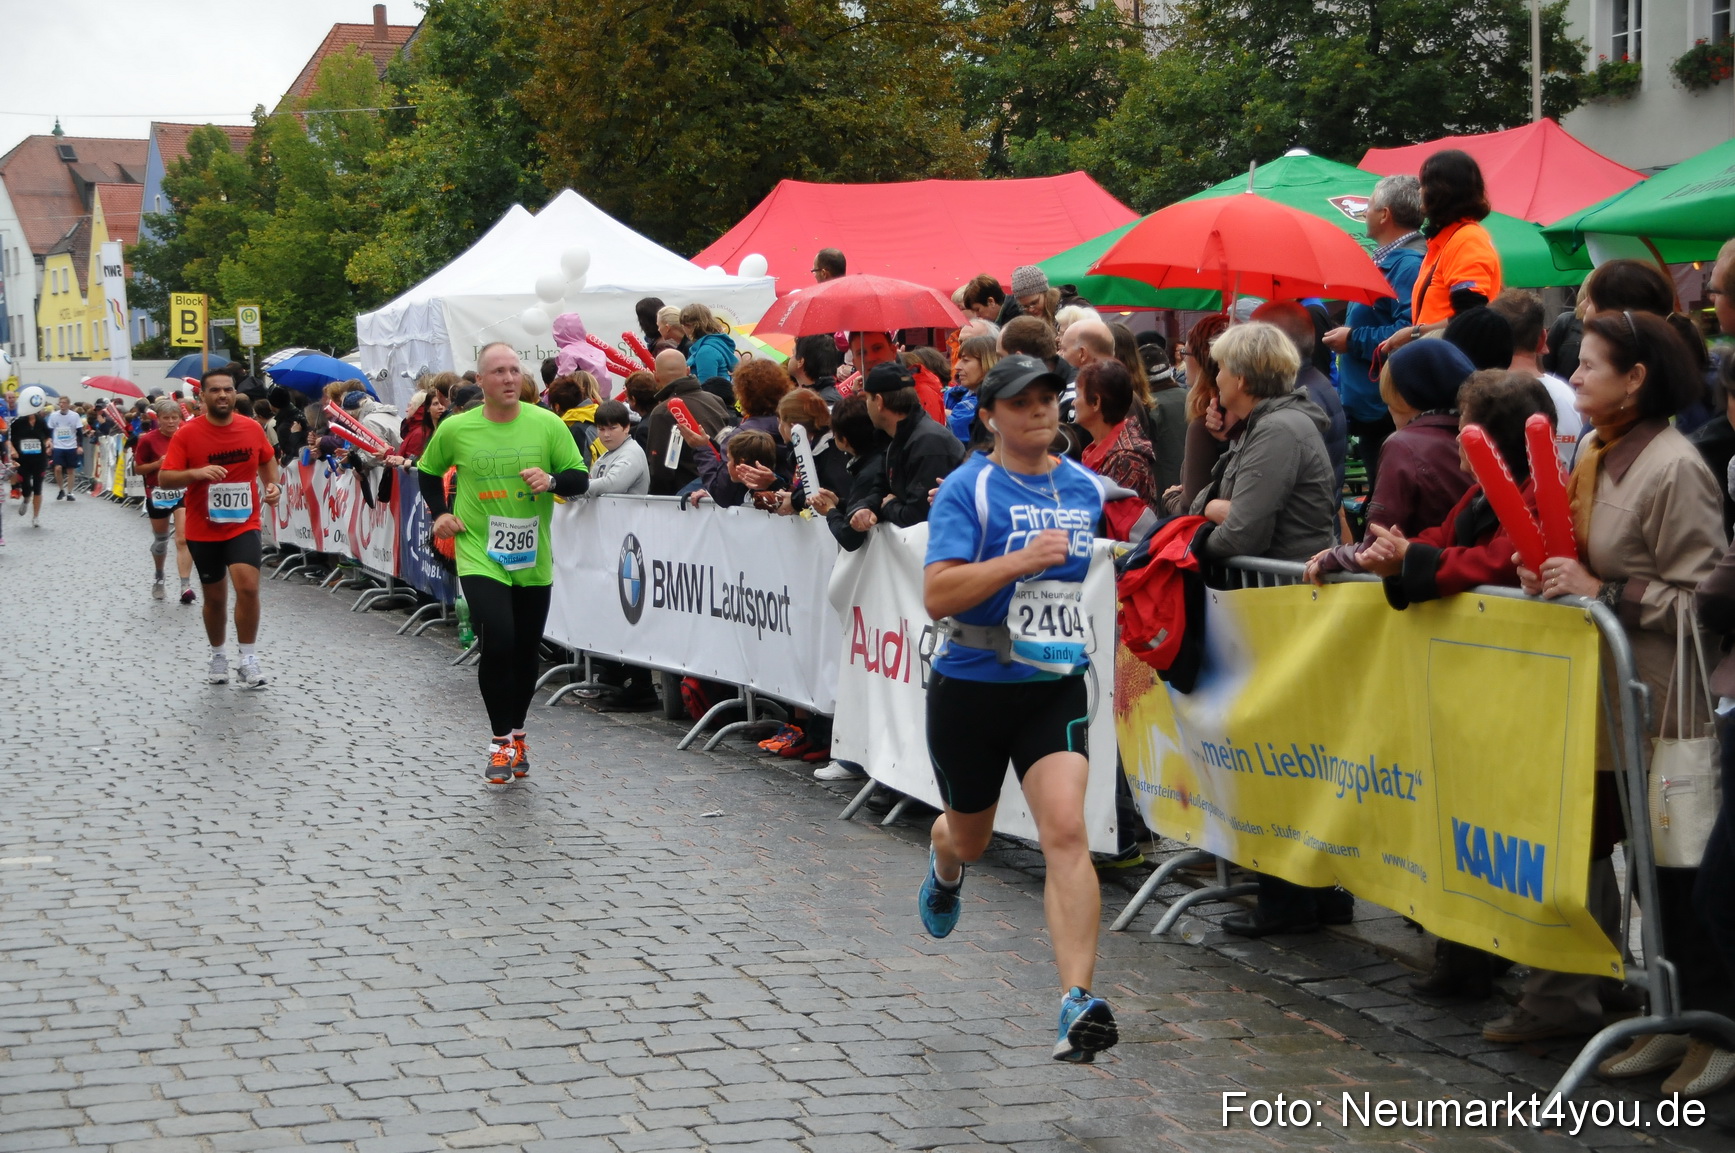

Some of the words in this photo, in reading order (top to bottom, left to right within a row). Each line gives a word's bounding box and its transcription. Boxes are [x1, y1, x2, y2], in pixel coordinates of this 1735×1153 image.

[176, 296, 203, 306] Block
[181, 310, 198, 335] B
[155, 491, 180, 500] 3190
[213, 493, 248, 507] 3070
[490, 521, 509, 529] PARTL
[1009, 504, 1091, 530] Fitness
[494, 529, 534, 551] 2396
[652, 559, 705, 615] BMW
[709, 565, 792, 641] Laufsport
[1015, 590, 1039, 600] ARTL
[1018, 604, 1085, 638] 2404
[850, 605, 911, 684] Audi
[1043, 646, 1074, 662] Sindy
[1451, 816, 1546, 903] KANN
